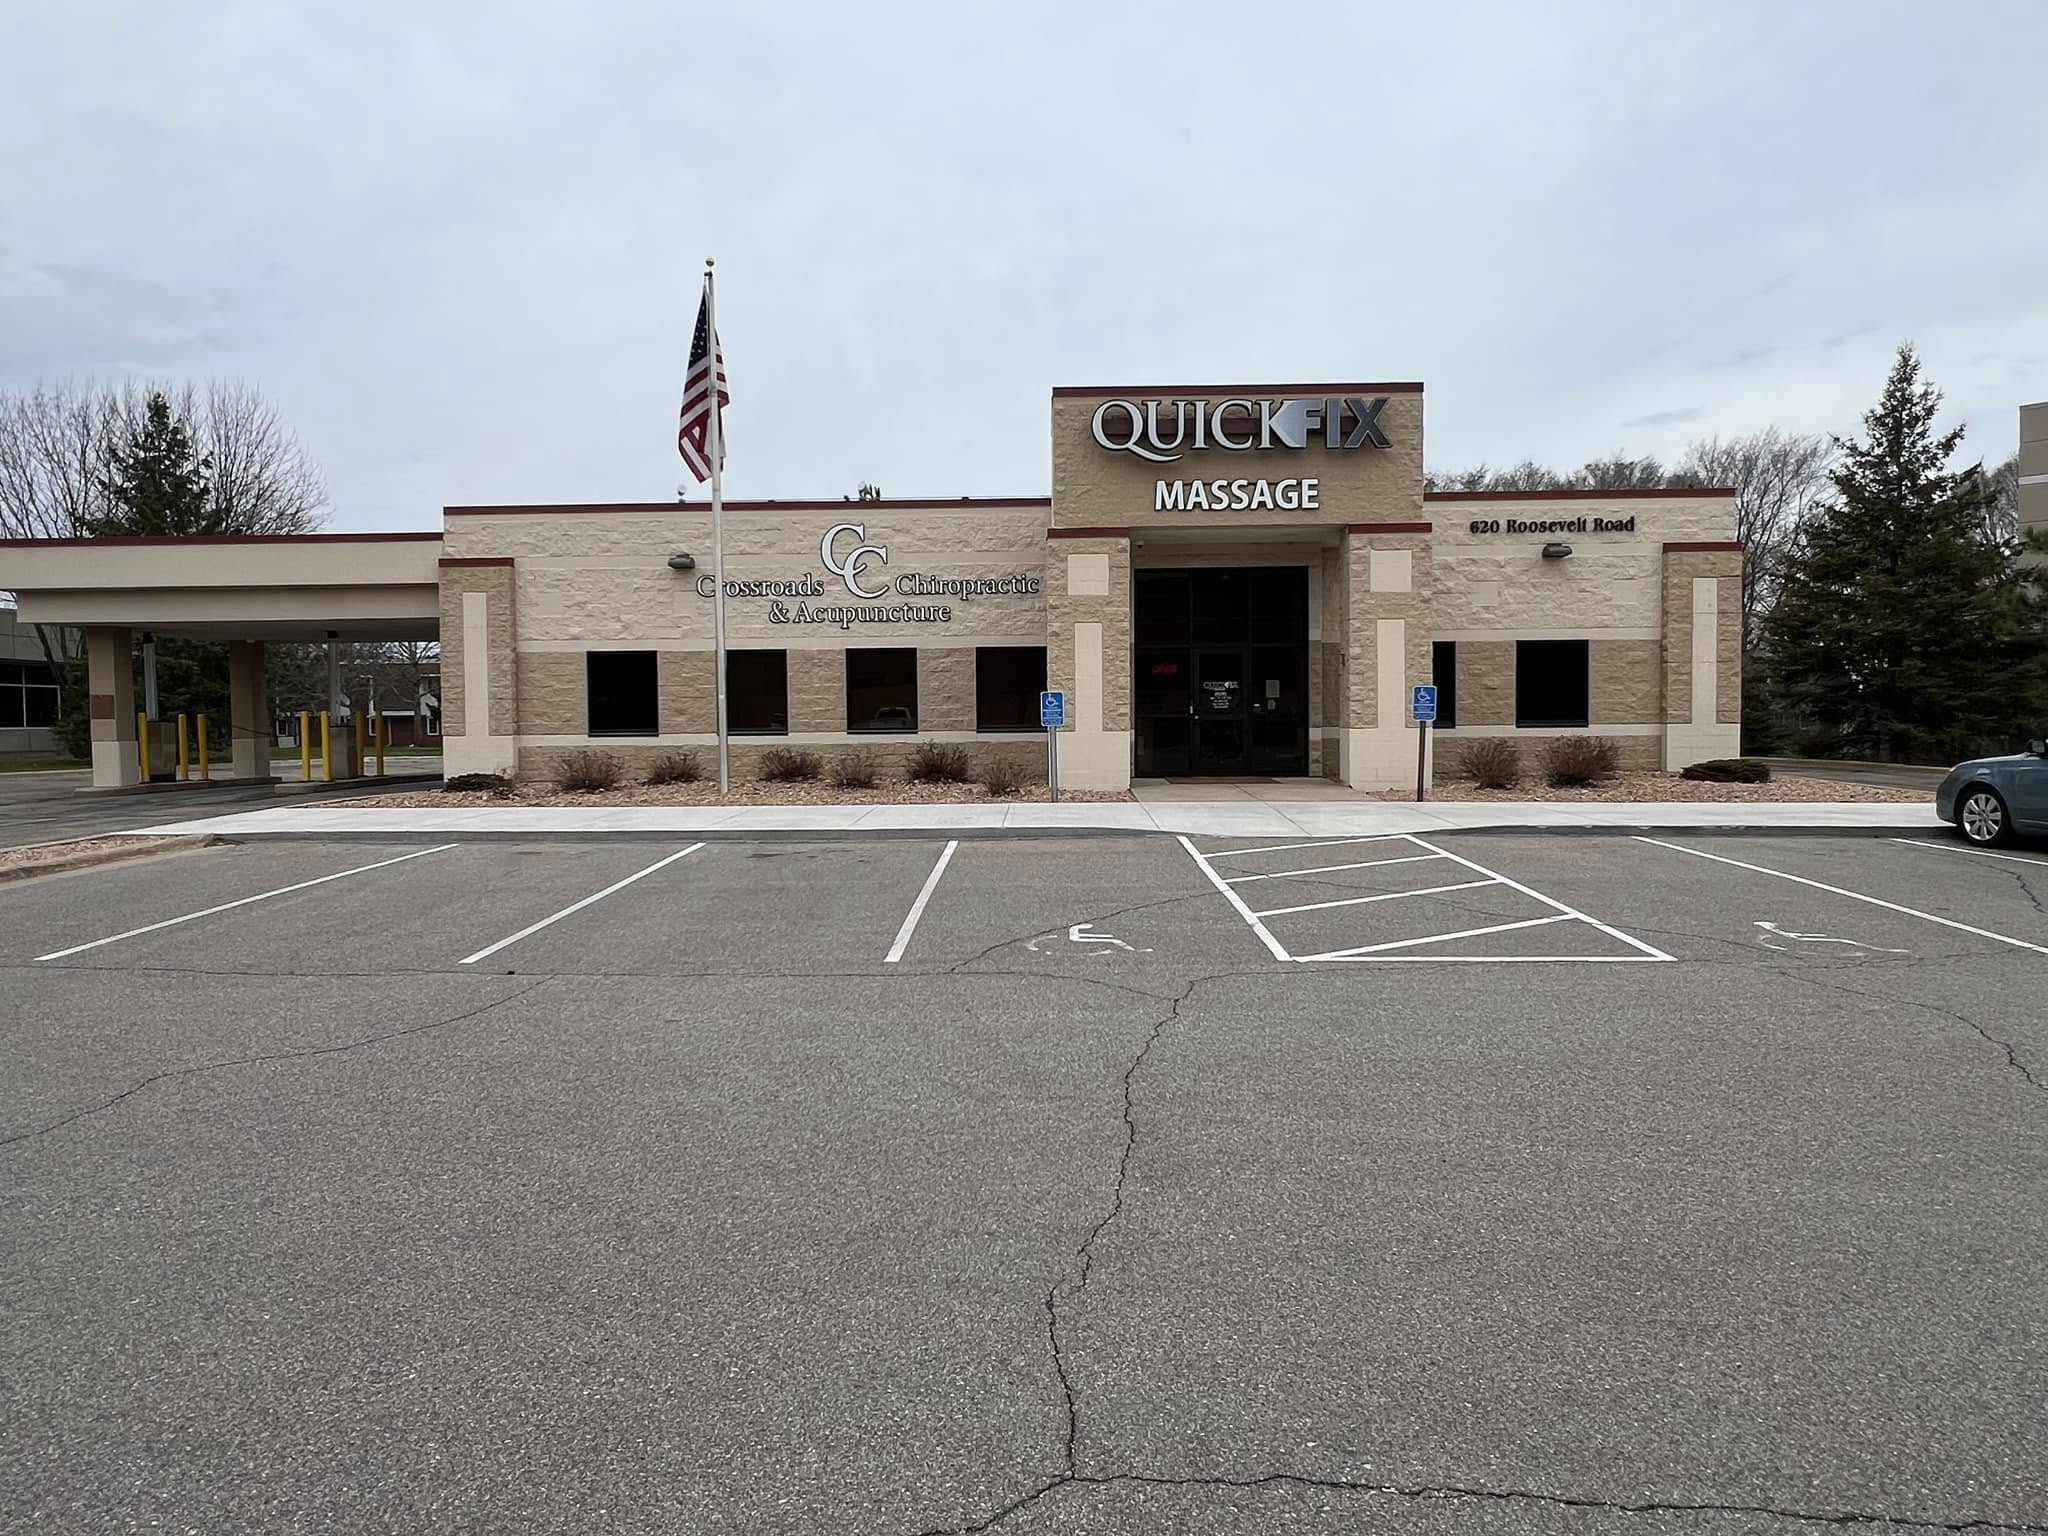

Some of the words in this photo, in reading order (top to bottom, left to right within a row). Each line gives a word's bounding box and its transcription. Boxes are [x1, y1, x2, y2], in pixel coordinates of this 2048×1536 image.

[1091, 397, 1393, 462] QUICKFIX
[1154, 478, 1320, 511] MASSAGE
[1469, 519, 1500, 534] 620
[1506, 517, 1587, 534] Roosevelt
[1592, 515, 1635, 533] Road
[894, 573, 1041, 601] Chiropractic
[768, 601, 790, 624] &
[793, 601, 952, 629] Acupuncture
